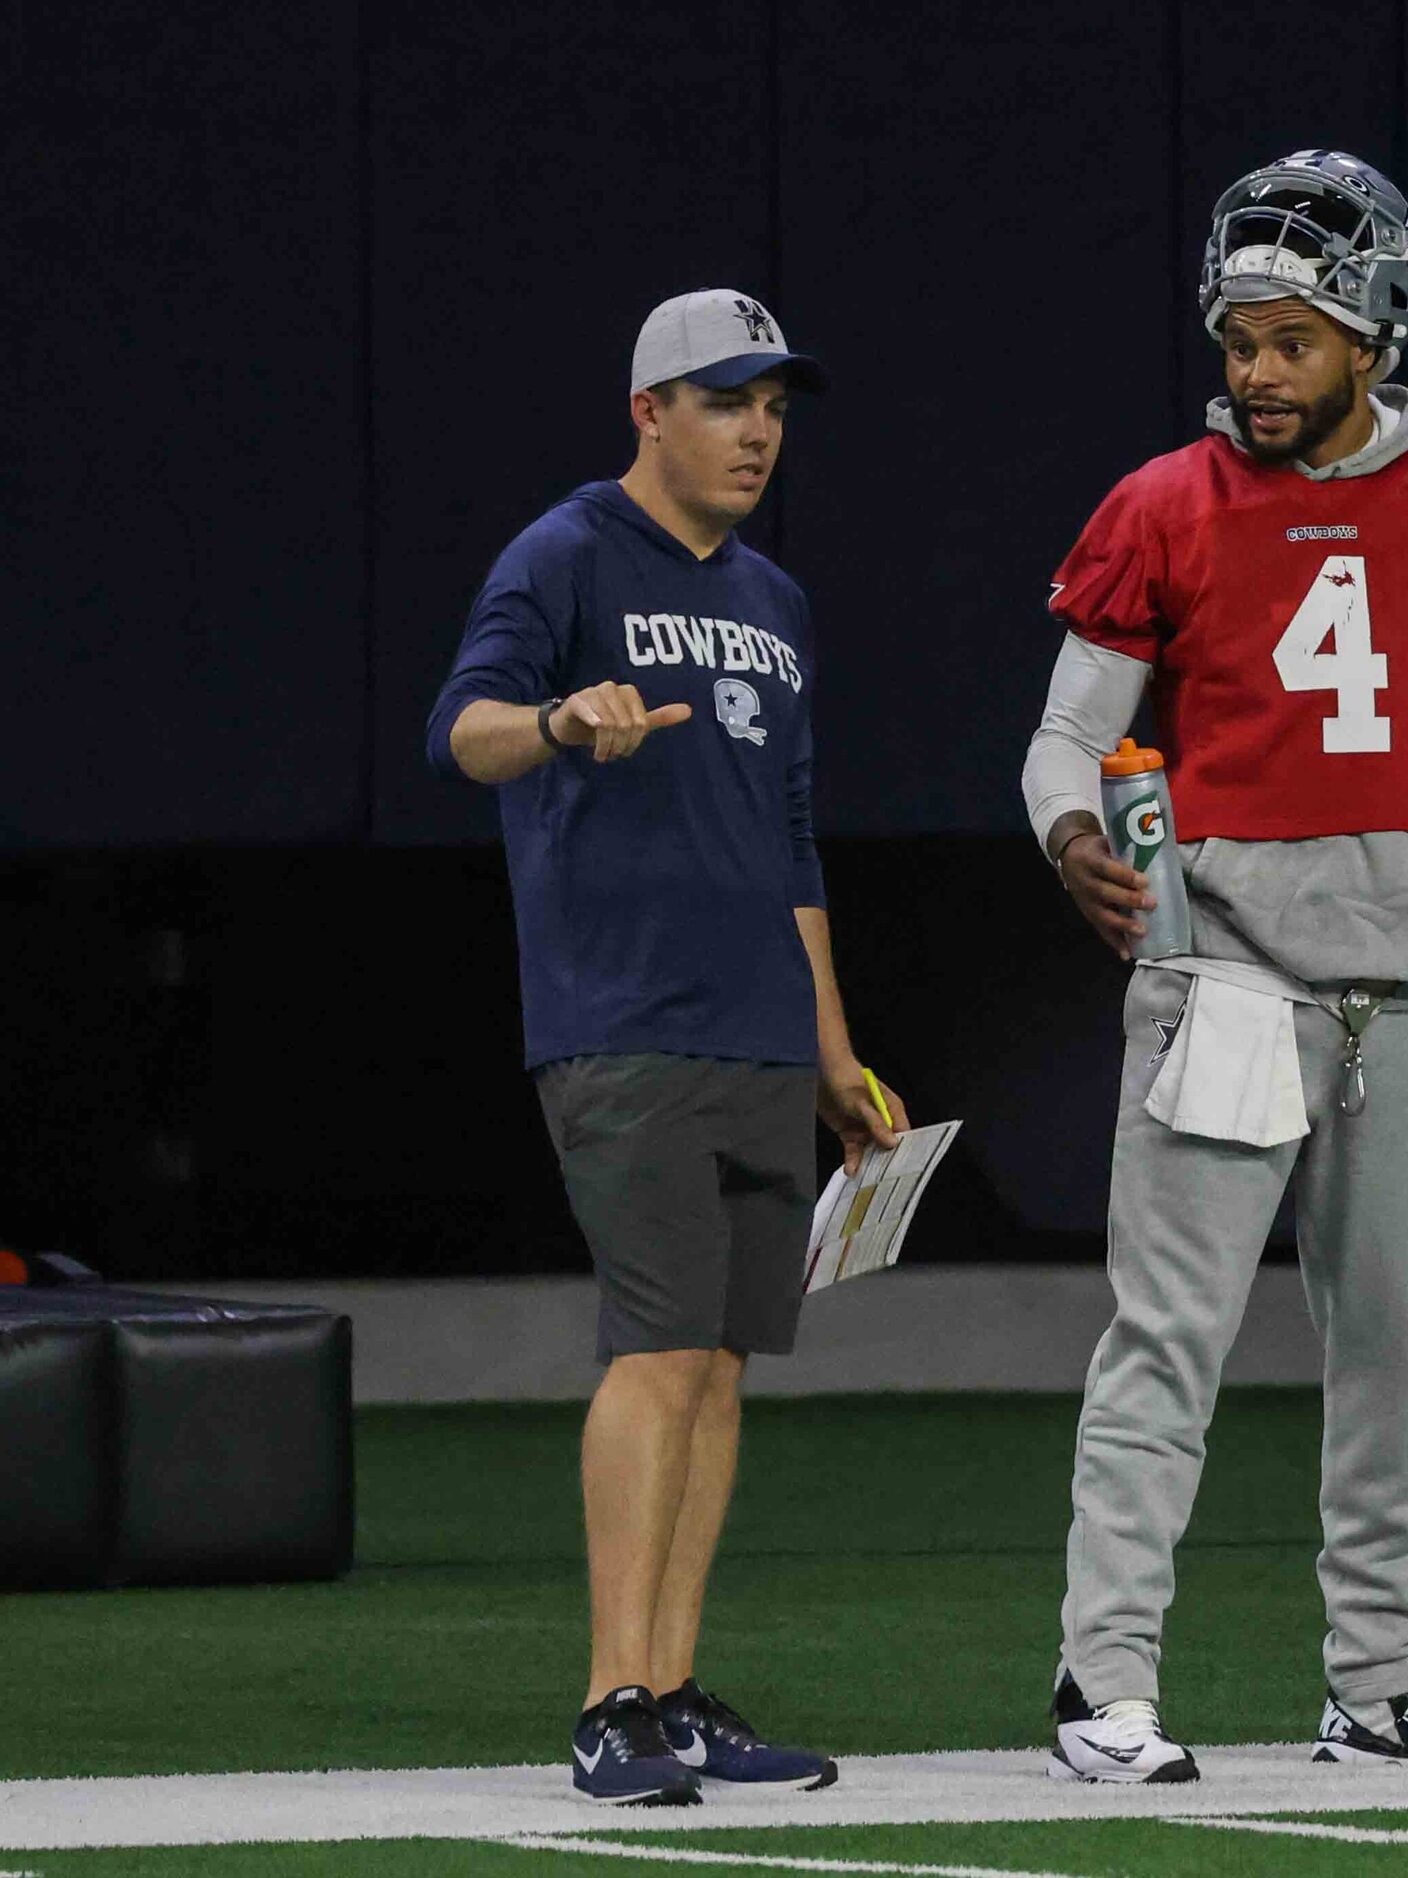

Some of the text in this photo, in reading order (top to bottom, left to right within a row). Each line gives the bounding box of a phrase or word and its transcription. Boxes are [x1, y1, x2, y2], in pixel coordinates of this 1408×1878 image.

[1286, 526, 1358, 542] COWBOYS
[623, 612, 803, 694] COWBOYS
[1272, 556, 1391, 753] 4
[1126, 799, 1164, 847] G
